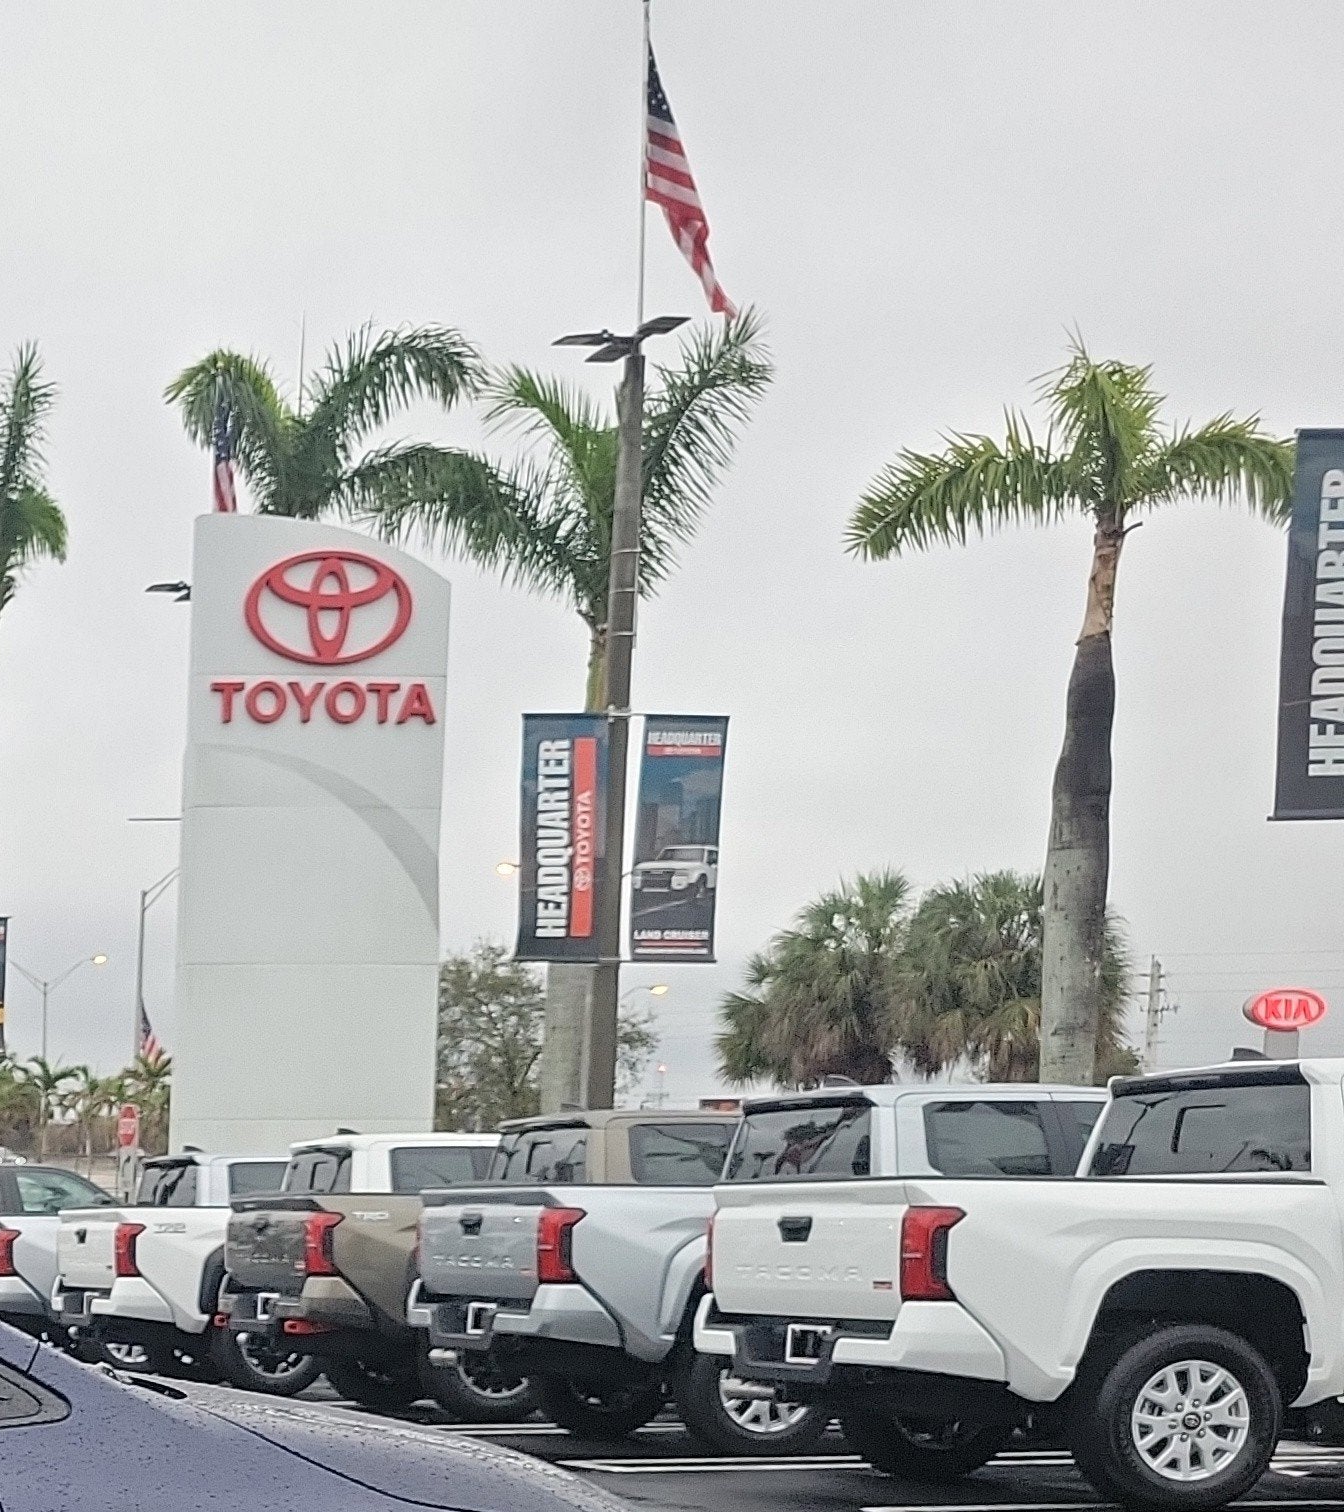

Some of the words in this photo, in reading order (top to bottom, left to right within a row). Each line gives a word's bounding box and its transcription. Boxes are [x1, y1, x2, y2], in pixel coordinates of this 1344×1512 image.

[210, 681, 436, 725] TOYOTA
[534, 738, 574, 938] HEADQUARTER
[573, 790, 593, 867] TOYOTA
[1265, 999, 1313, 1020] KIA
[736, 1265, 861, 1282] TACOMA
